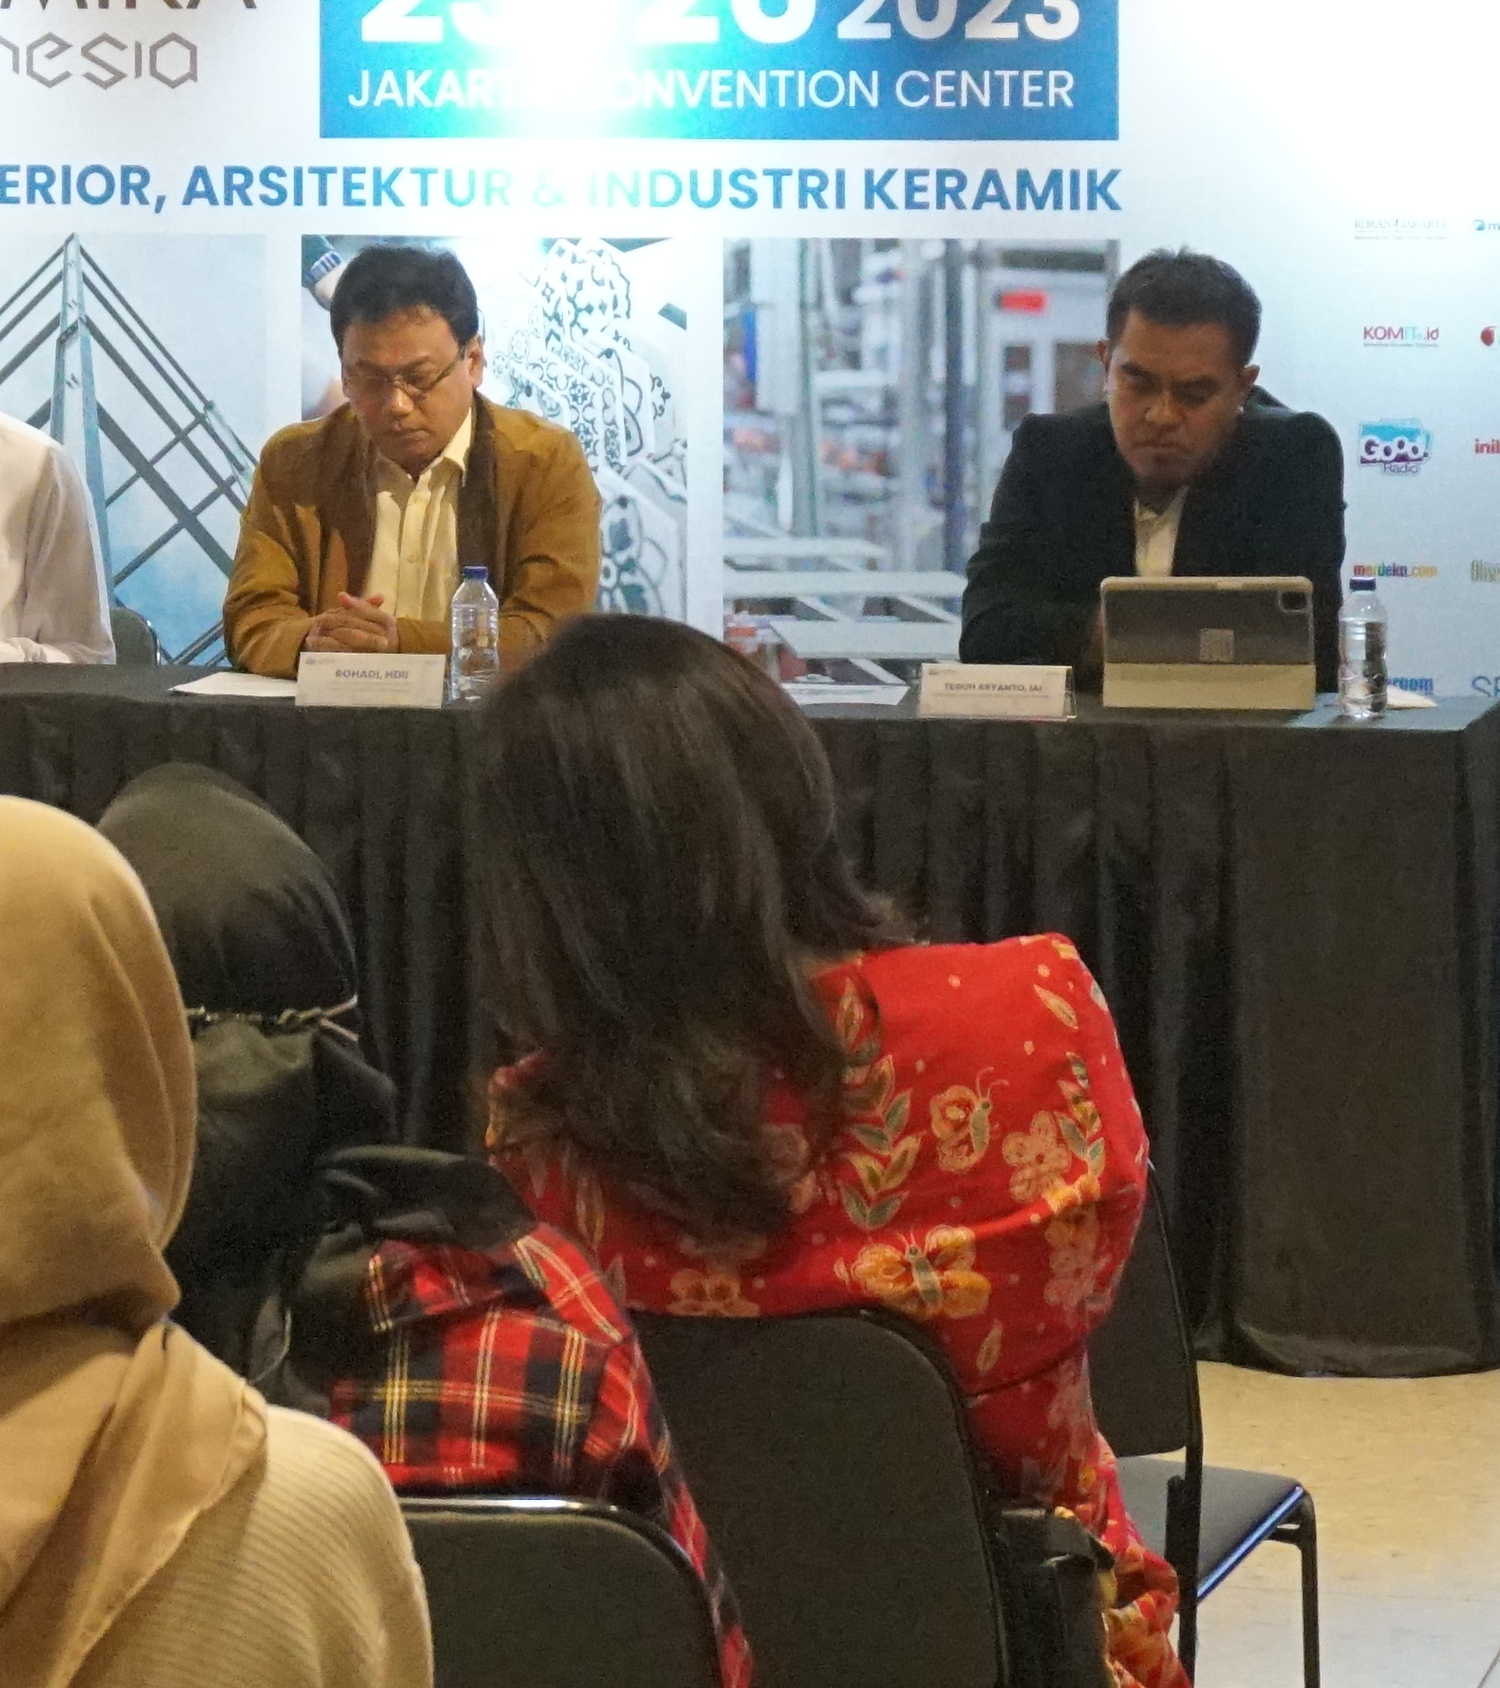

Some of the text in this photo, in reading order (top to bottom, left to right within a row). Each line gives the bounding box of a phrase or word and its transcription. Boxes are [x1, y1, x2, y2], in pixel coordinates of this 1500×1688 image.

[347, 68, 1075, 110] JAKART ONVENTION CENTER
[180, 164, 513, 209] ARSITEKTUR
[530, 169, 569, 210] &
[590, 166, 847, 211] INDUSTRI
[864, 167, 1125, 212] KERAMIK
